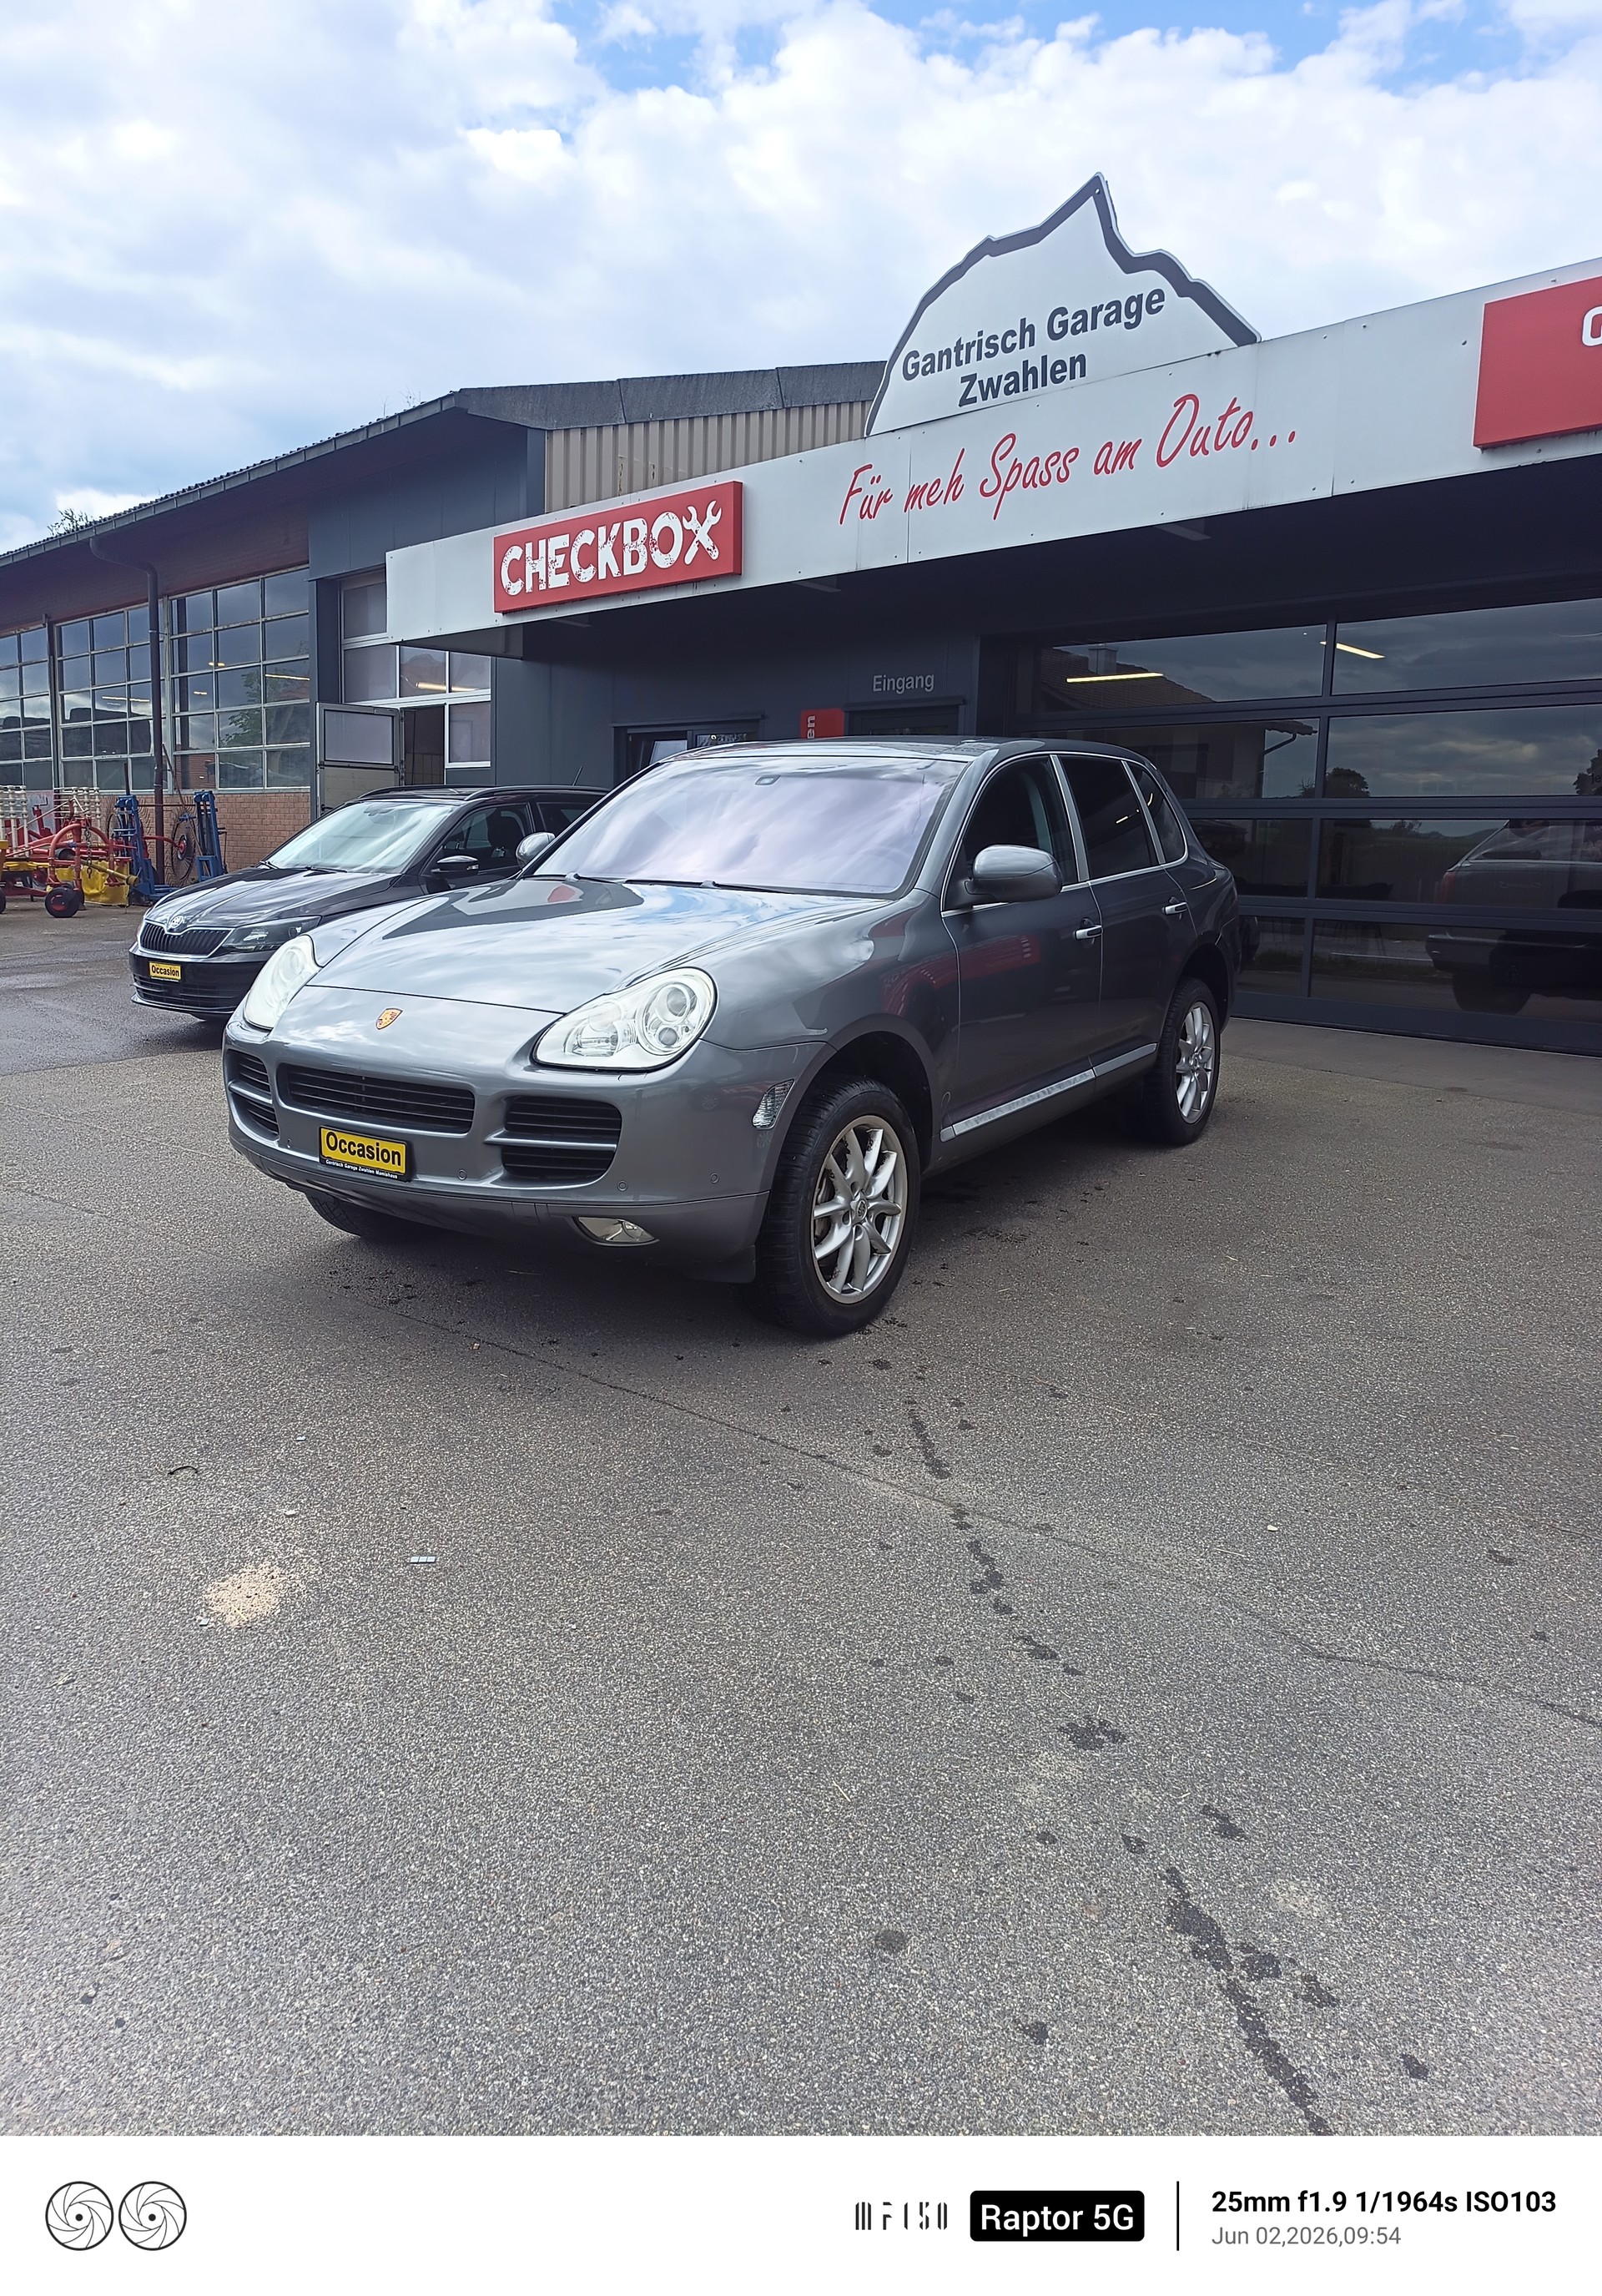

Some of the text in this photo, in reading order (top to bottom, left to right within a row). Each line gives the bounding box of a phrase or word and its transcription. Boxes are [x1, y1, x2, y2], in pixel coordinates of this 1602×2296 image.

[902, 288, 1166, 381] Gantrisch Garage
[958, 353, 1086, 407] Zwahlen
[839, 463, 894, 525] Für
[904, 447, 965, 514] meh
[978, 432, 1080, 521] Spass
[1093, 438, 1142, 476] am
[500, 500, 723, 596] CHECKBOX
[872, 674, 934, 694] Eingang
[151, 965, 179, 977] Occasion
[325, 1131, 401, 1167] Occasion
